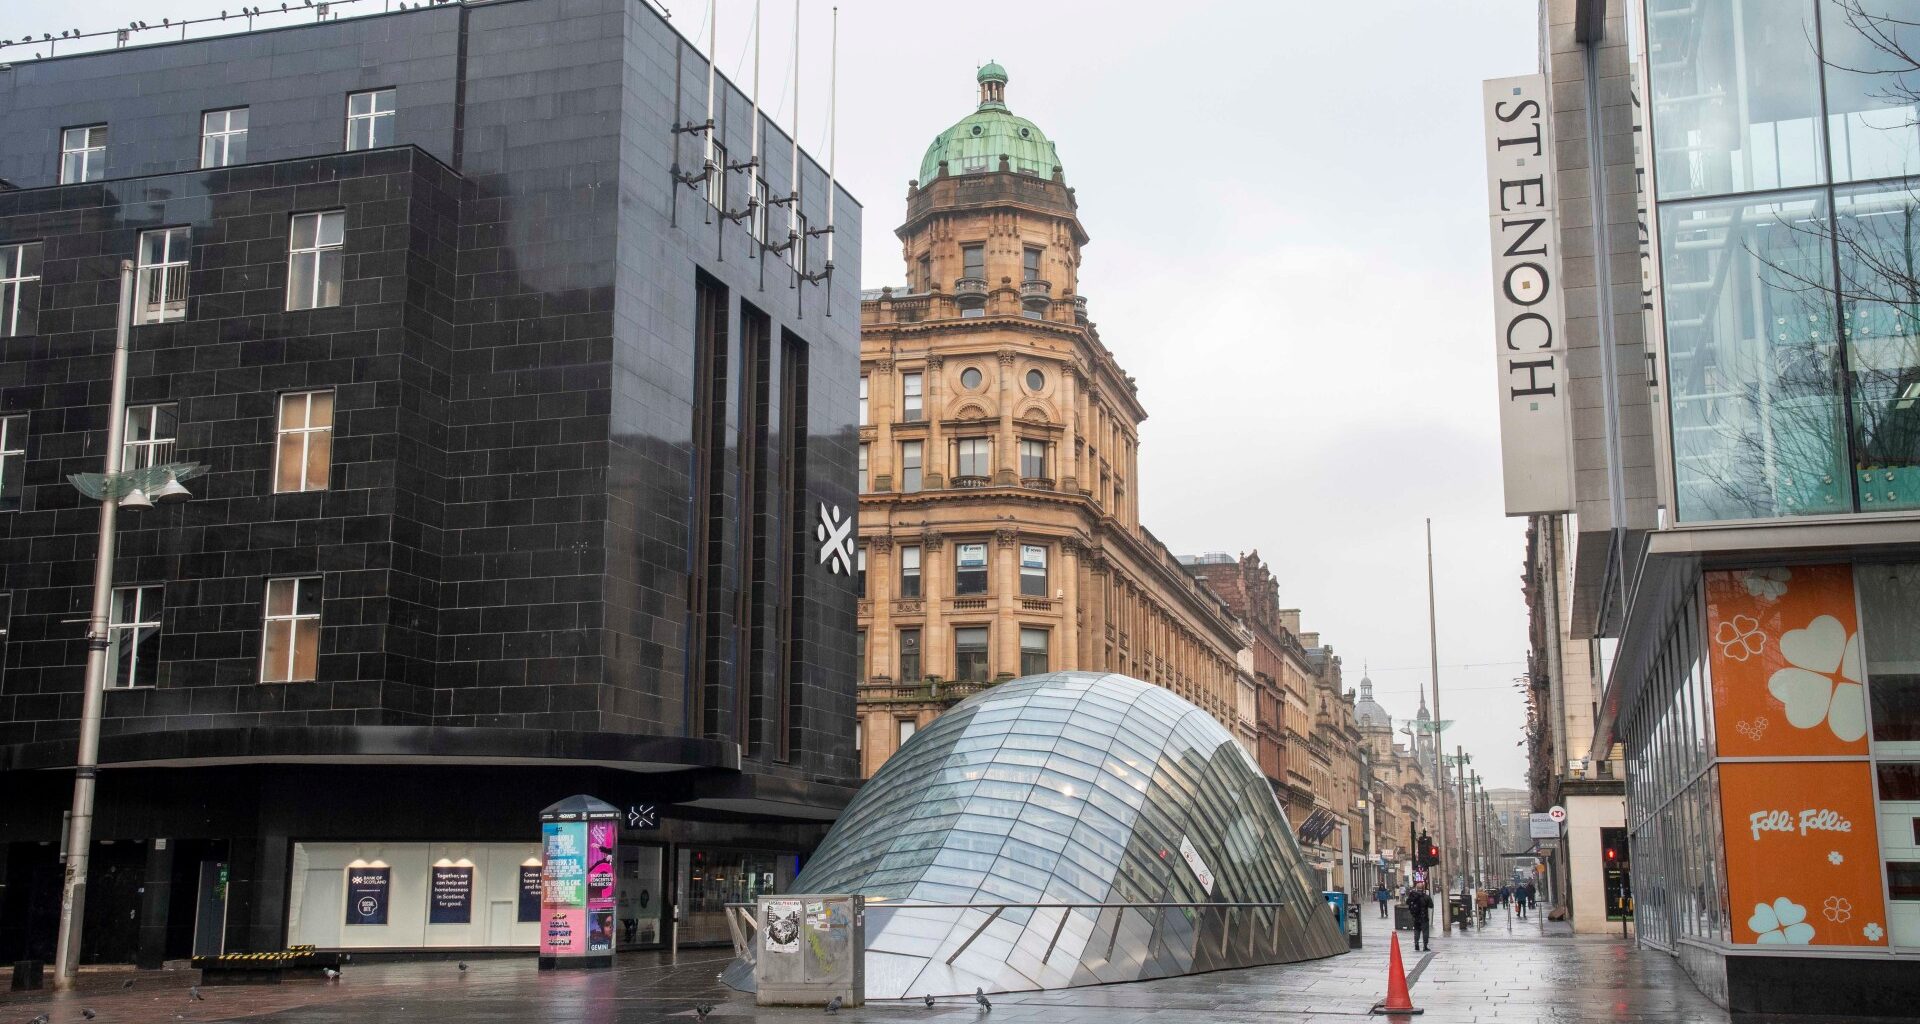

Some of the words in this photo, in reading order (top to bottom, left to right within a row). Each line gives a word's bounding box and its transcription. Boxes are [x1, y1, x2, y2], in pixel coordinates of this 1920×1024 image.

[1495, 100, 1542, 156] ST
[1500, 174, 1556, 402] ENOCH
[1749, 810, 1795, 841] Folli
[1799, 808, 1852, 837] Follie
